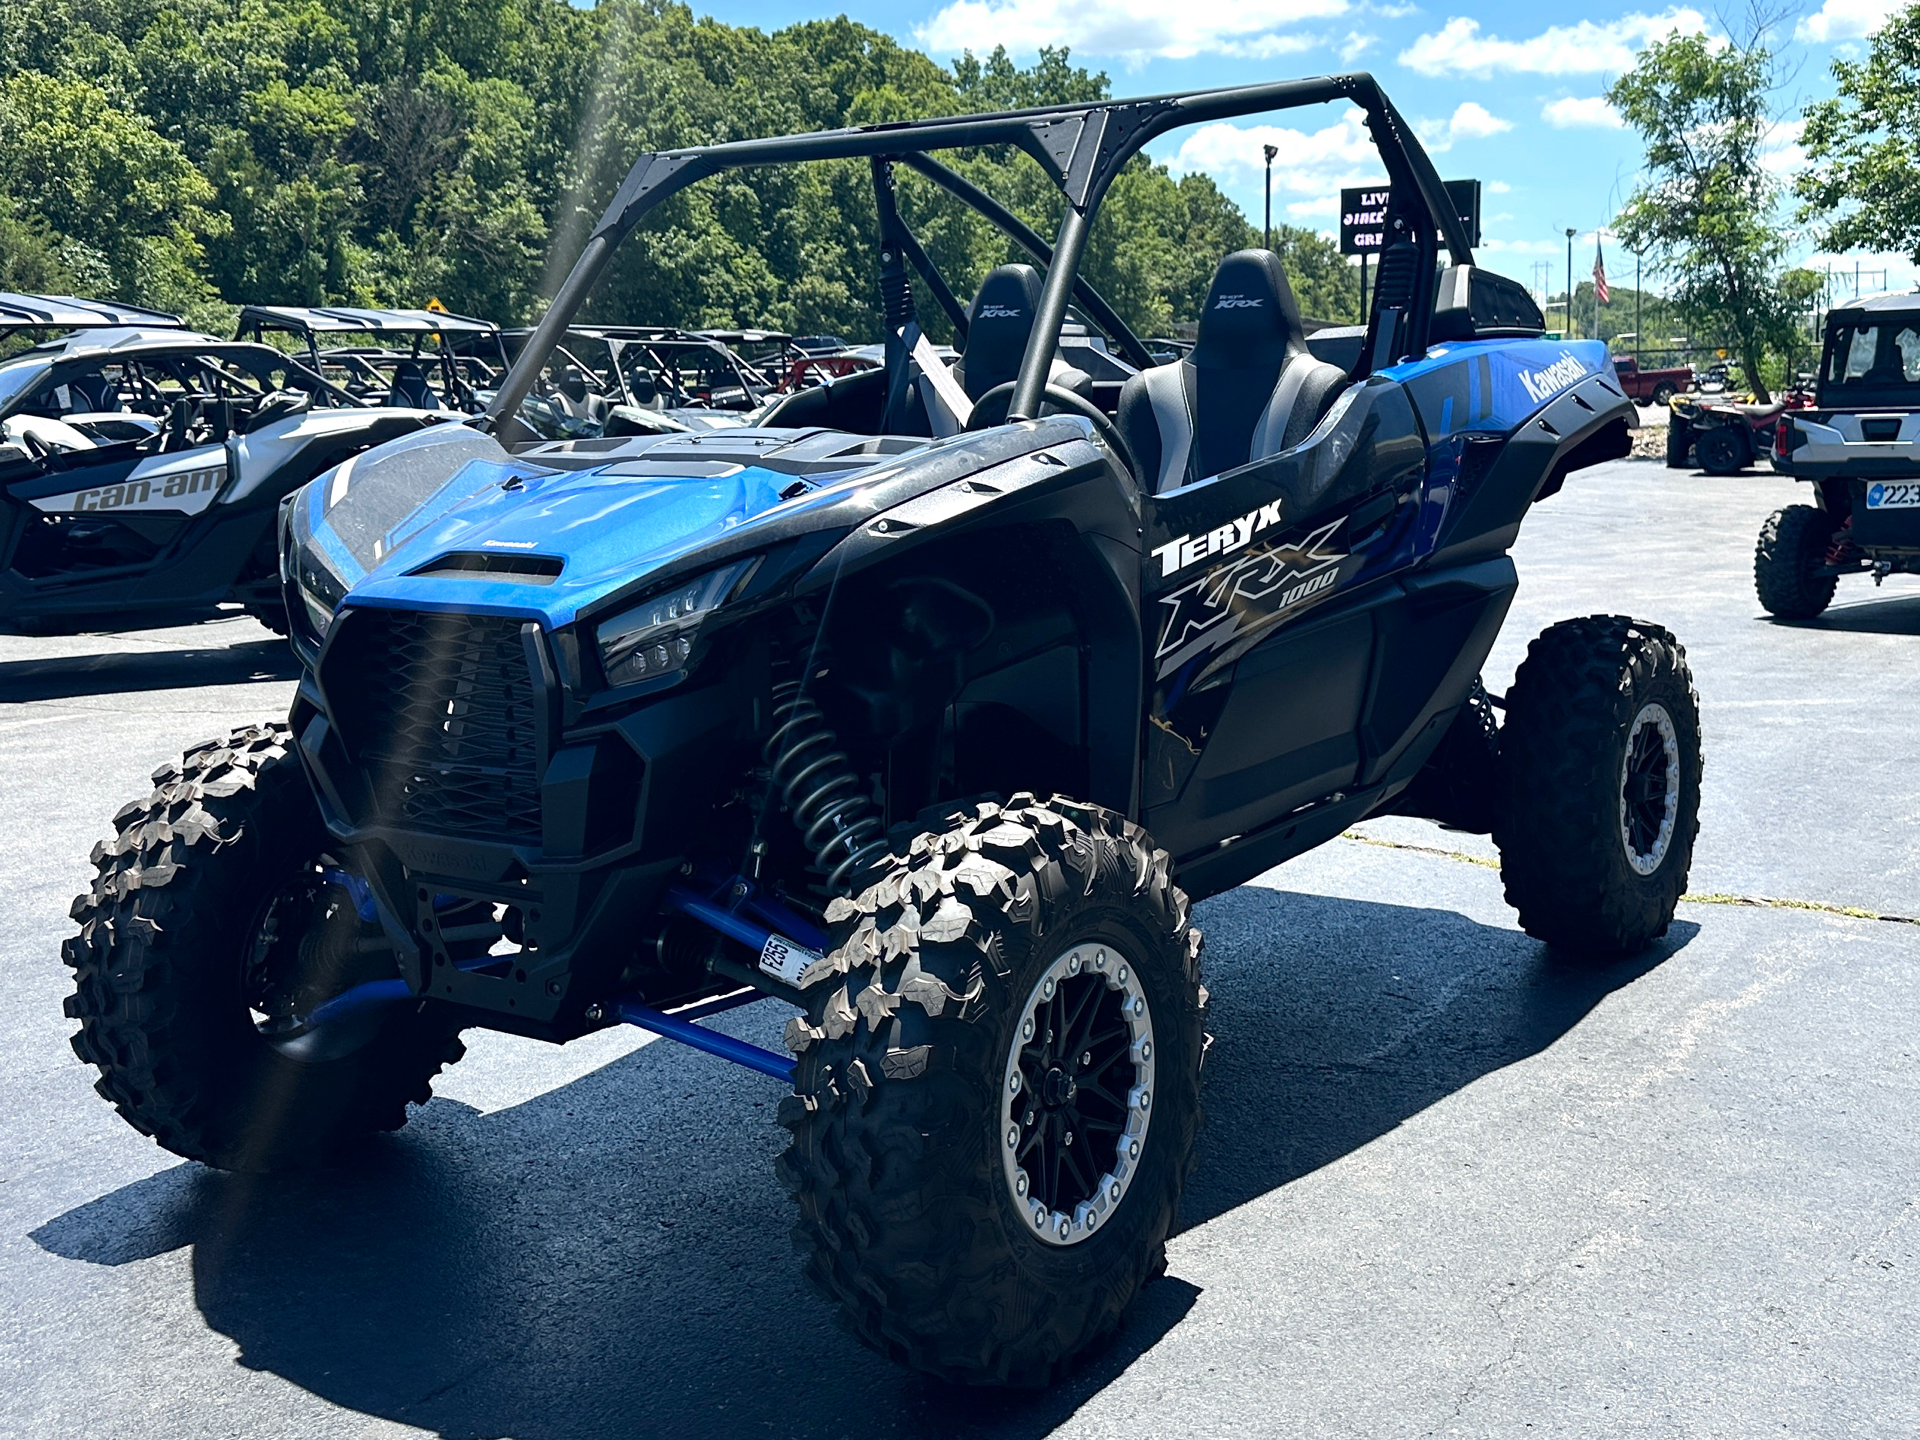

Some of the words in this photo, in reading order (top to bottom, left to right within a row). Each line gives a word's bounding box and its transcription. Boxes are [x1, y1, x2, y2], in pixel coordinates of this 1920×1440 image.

[1361, 192, 1389, 206] LIV
[979, 309, 1020, 318] KRX
[1214, 299, 1264, 309] KRX
[1517, 349, 1588, 404] Kawasaki
[73, 467, 227, 512] can-am
[1151, 498, 1283, 578] TERYX
[1155, 514, 1350, 660] KRX
[1278, 566, 1340, 609] 1000
[761, 940, 789, 972] F255
